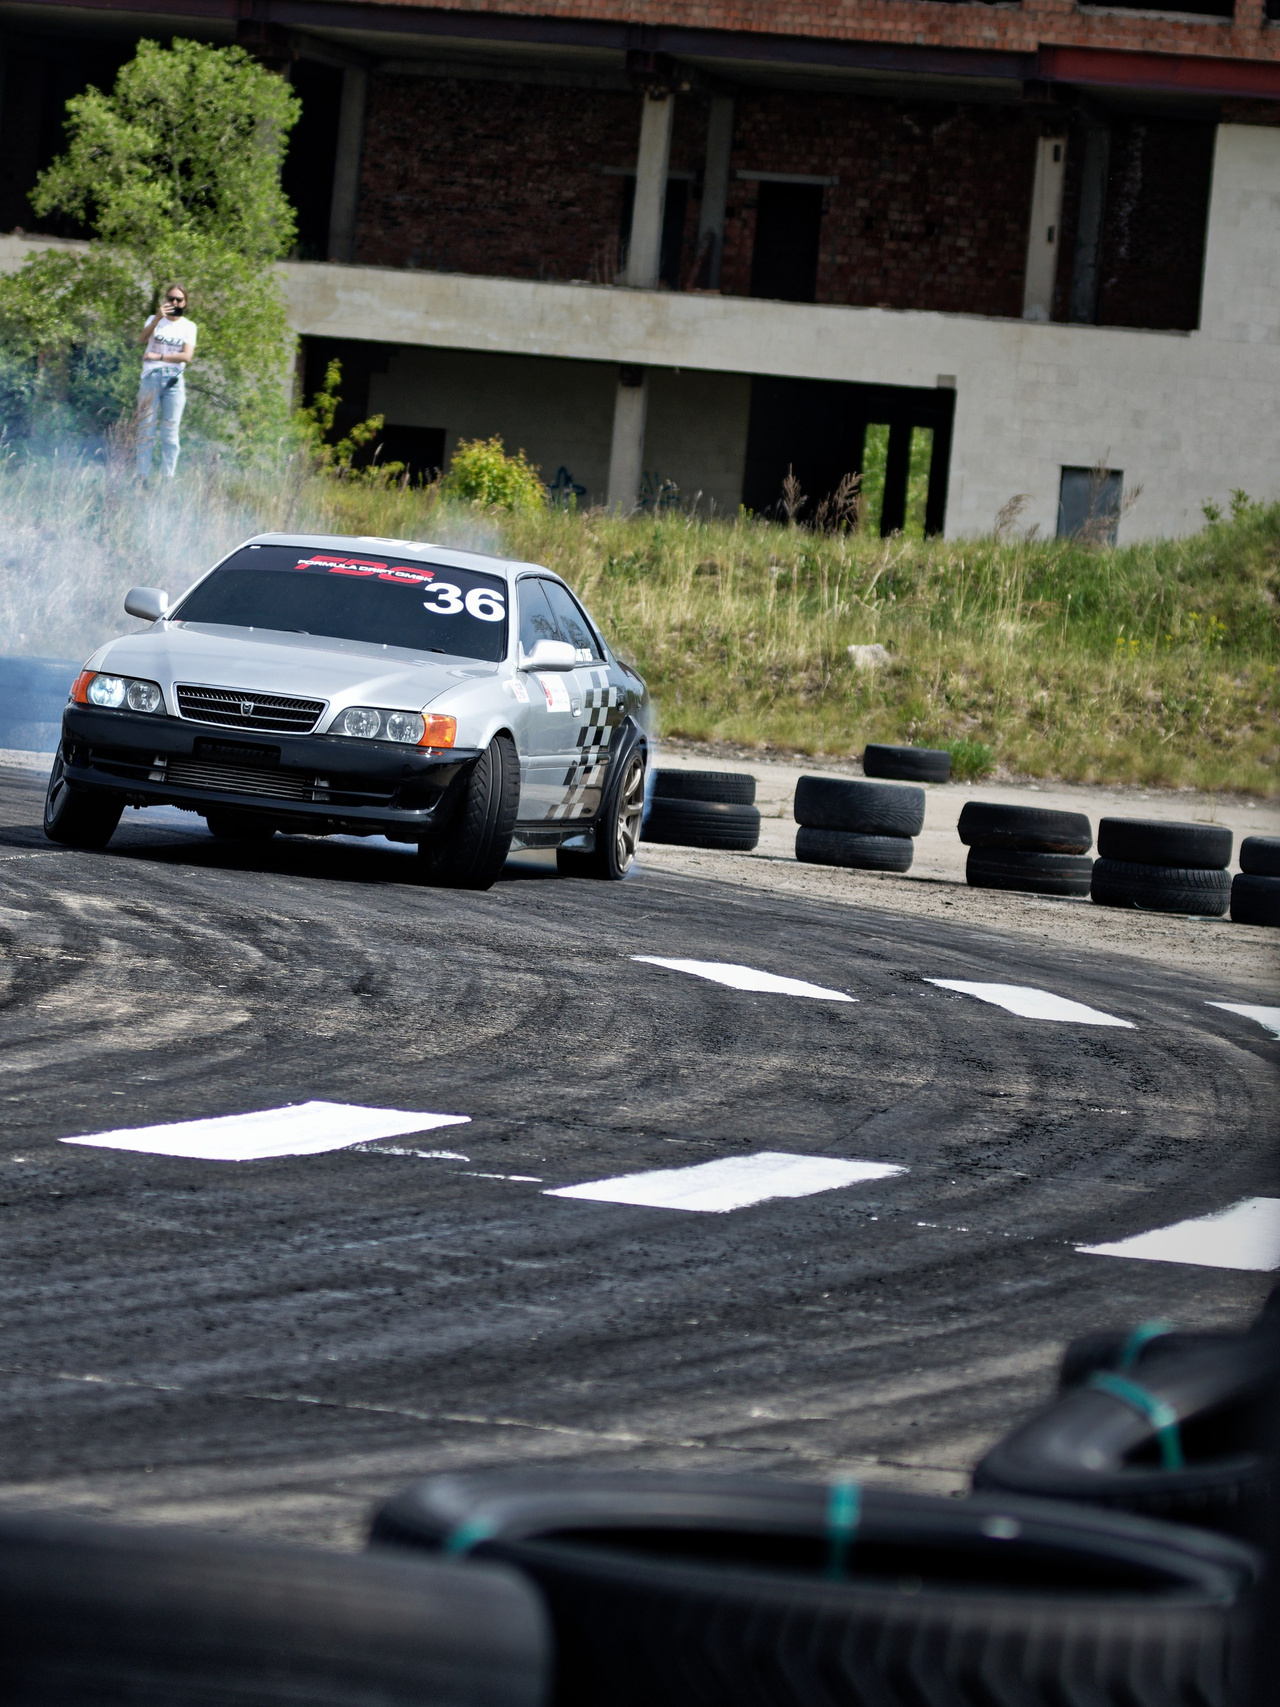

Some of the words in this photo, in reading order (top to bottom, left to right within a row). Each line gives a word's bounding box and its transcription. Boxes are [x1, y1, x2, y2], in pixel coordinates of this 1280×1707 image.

[297, 559, 358, 570] FORMULA
[358, 565, 396, 576] DRIFT
[395, 570, 434, 583] OMSK
[423, 582, 506, 622] 36
